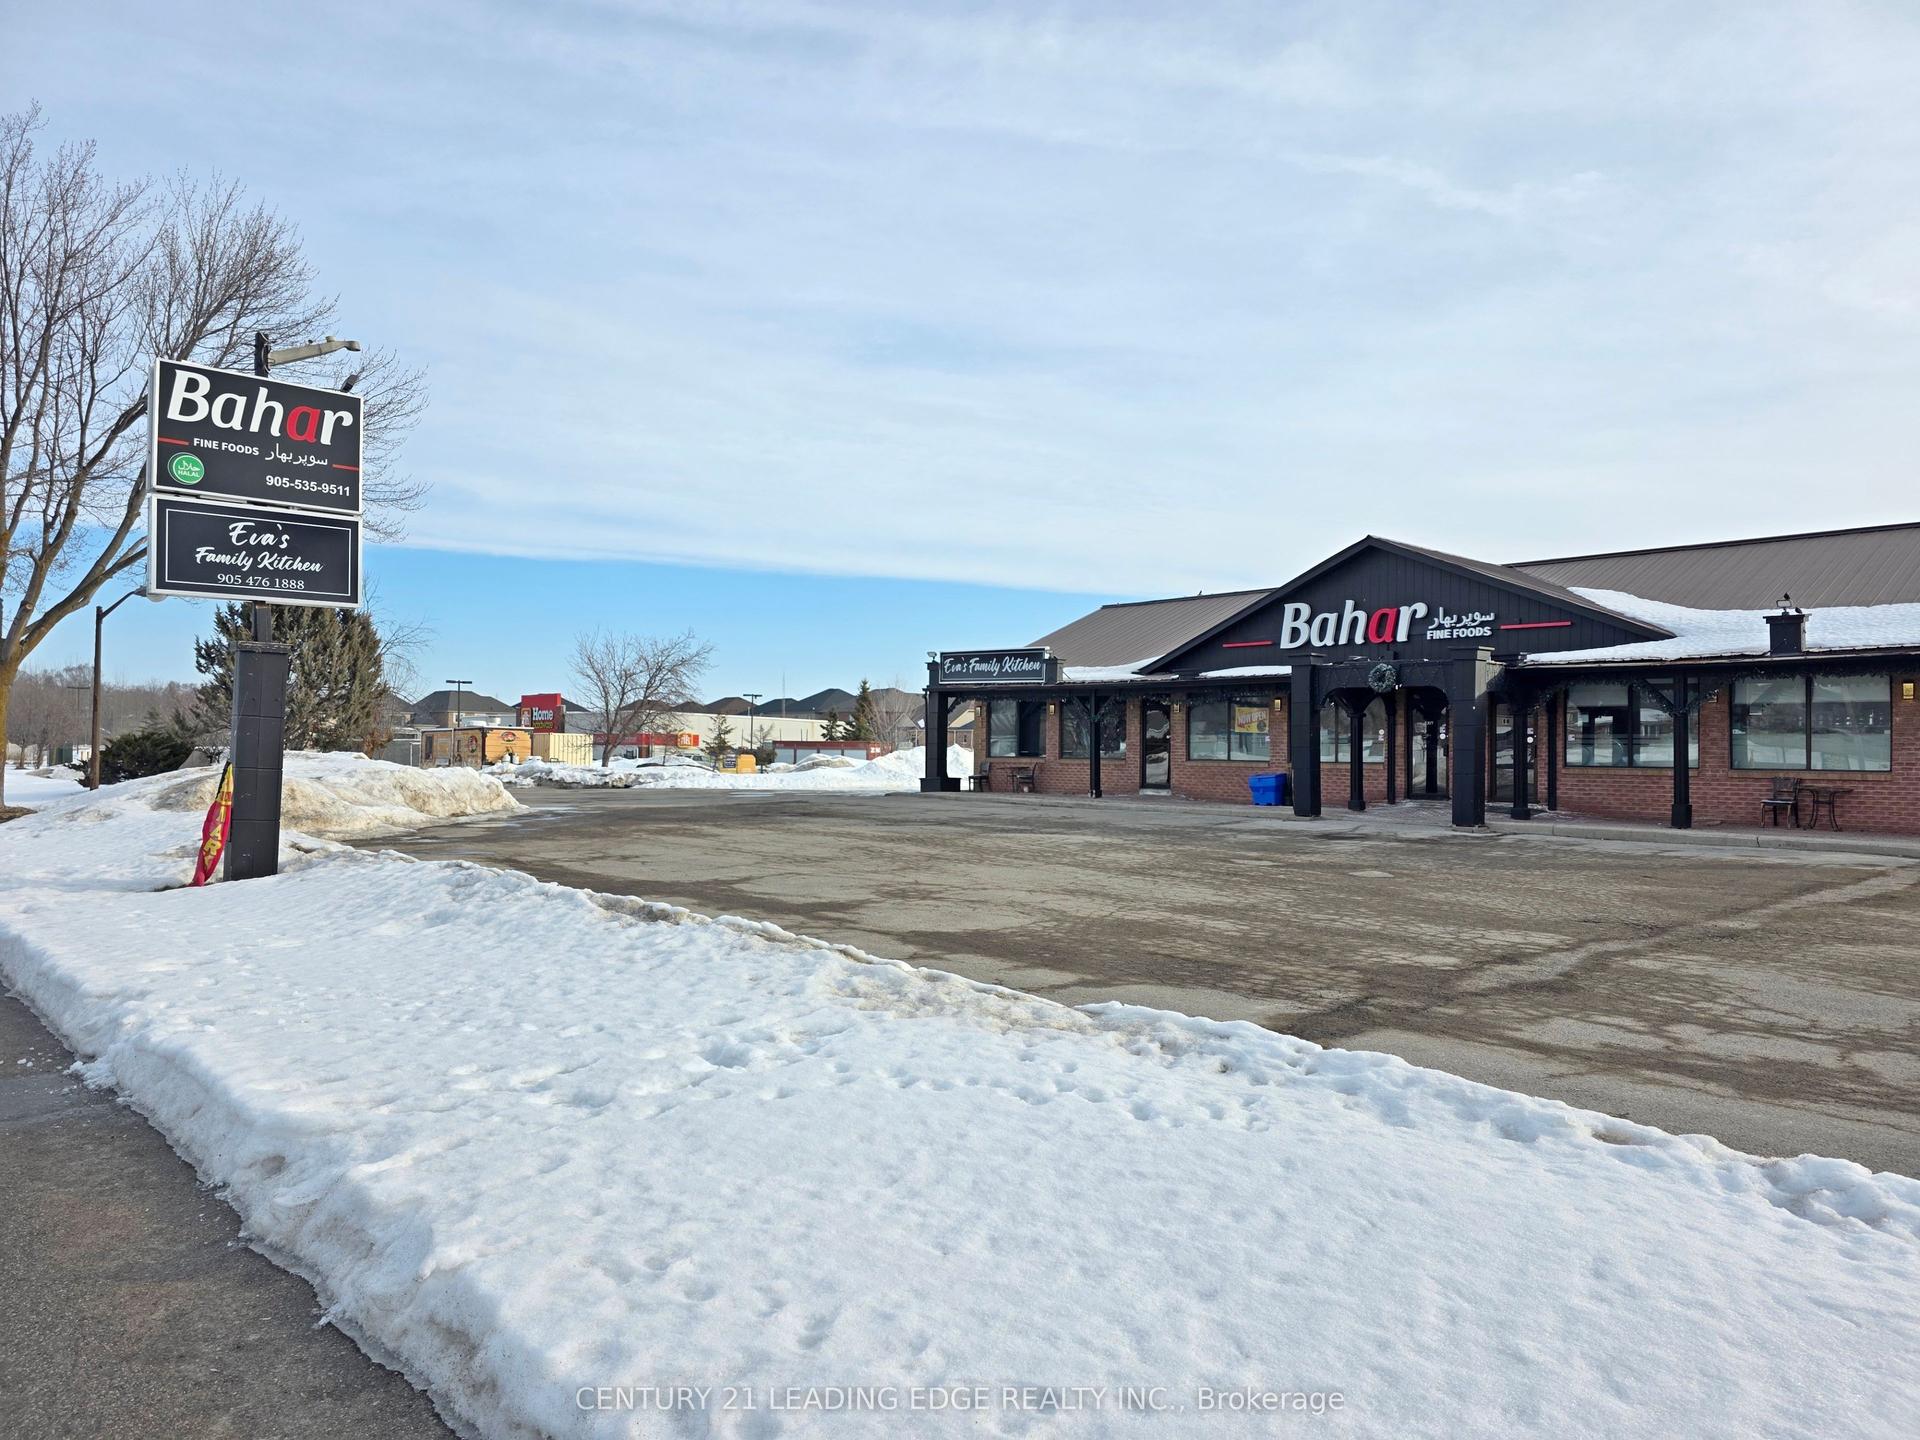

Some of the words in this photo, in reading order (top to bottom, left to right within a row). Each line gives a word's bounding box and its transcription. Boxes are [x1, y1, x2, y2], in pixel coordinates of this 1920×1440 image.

[167, 369, 353, 445] Bahar
[193, 438, 219, 450] FINE
[221, 442, 260, 456] FOODS
[178, 470, 201, 478] HALAL
[266, 475, 350, 497] 905-535-9511
[195, 546, 253, 571] Family
[257, 552, 323, 573] Kitchen
[217, 573, 242, 585] 905
[246, 575, 270, 587] 476
[274, 578, 305, 590] 1888
[1279, 599, 1429, 650] Bahar
[1426, 629, 1452, 640] FINE
[1453, 626, 1493, 639] FOODS
[969, 657, 1000, 677] Family
[1002, 655, 1041, 673] Kitchen
[532, 707, 553, 720] Home
[1251, 710, 1266, 721] OPEN
